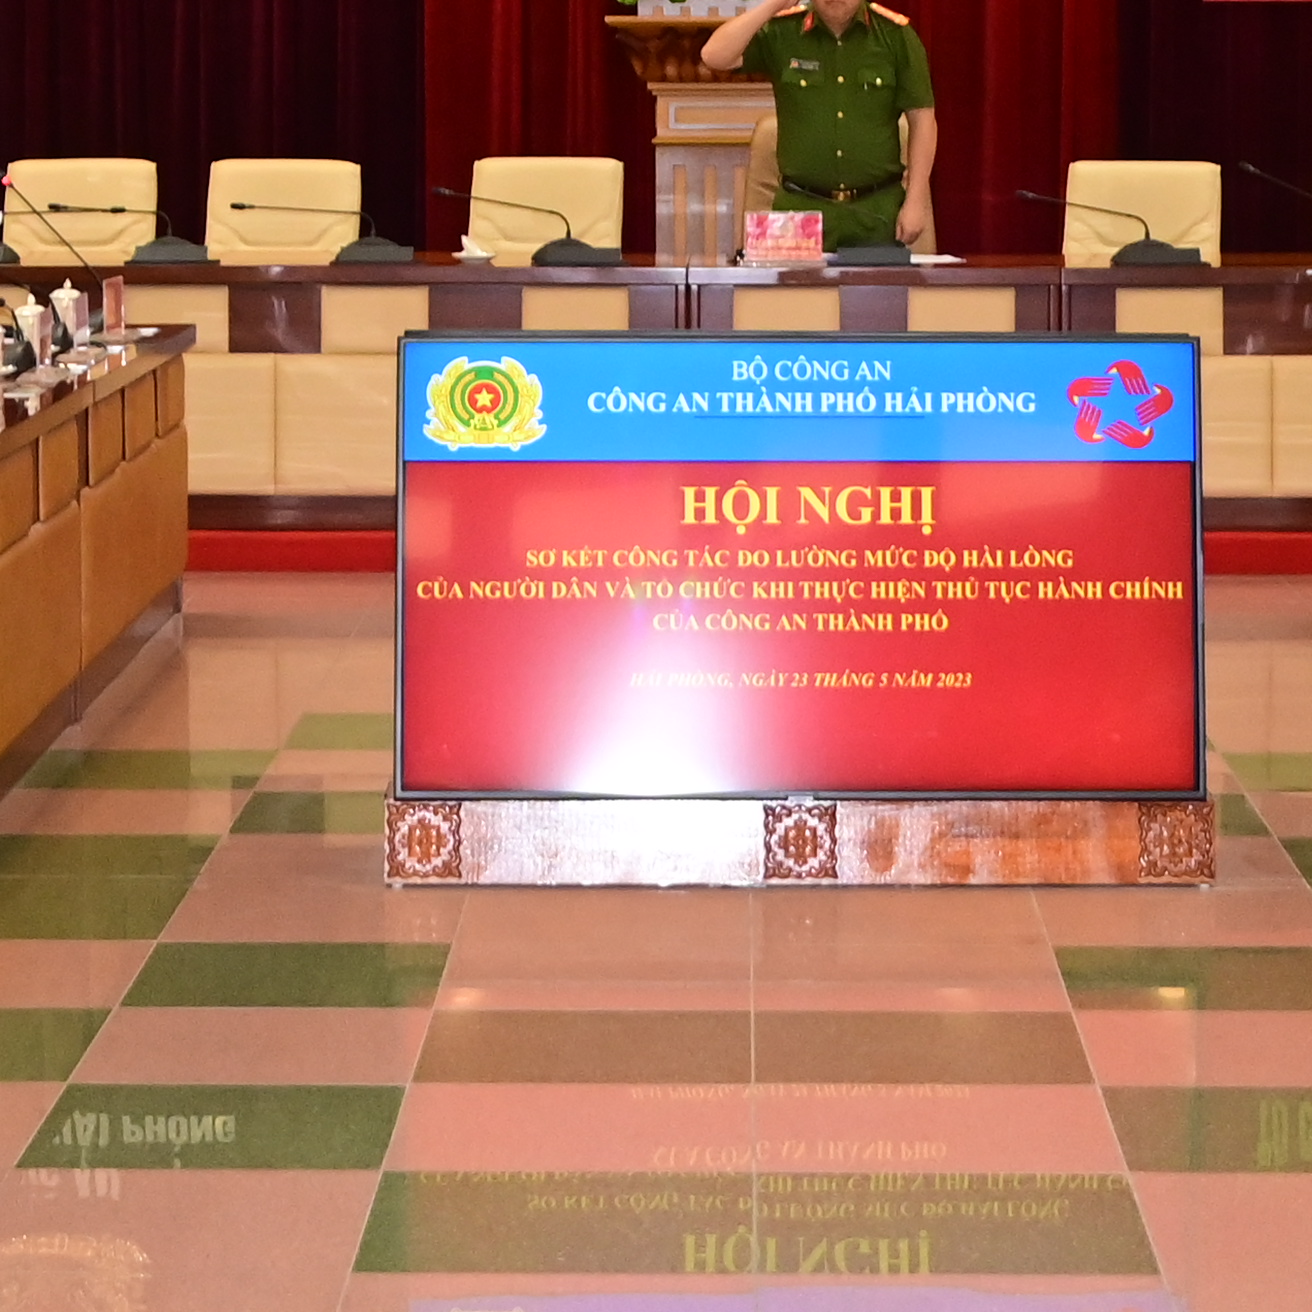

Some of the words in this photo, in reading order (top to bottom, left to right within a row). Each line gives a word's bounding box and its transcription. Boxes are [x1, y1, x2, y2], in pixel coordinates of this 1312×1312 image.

[733, 355, 768, 384] BỘ
[775, 355, 849, 381] CÔNG
[855, 361, 891, 380] AN
[588, 386, 666, 412] CÔNG
[673, 392, 708, 412] AN
[717, 387, 813, 412] THÀNH
[885, 387, 932, 412] HẢI
[941, 387, 1035, 412] PHÒNG
[681, 480, 780, 535] HỘI
[797, 486, 935, 535] NGHỊ
[527, 549, 556, 567] SƠ
[613, 545, 677, 567] CÔNG
[684, 545, 730, 568] TÁC
[738, 550, 769, 567] ĐO
[776, 545, 856, 567] LƯỜNG
[865, 545, 917, 567] MỨC
[924, 548, 956, 571] ĐỘ
[963, 545, 1002, 567] HÀI
[1010, 545, 1073, 567] LÒNG
[417, 577, 463, 599] CỦA
[470, 576, 544, 599] NGƯỜI
[552, 577, 597, 598] DÂN
[605, 577, 635, 599] VÀ
[678, 576, 745, 599] CHỨC
[753, 582, 794, 599] KHI
[799, 579, 864, 603] THỰC
[871, 579, 925, 603] HIỆN
[932, 577, 978, 598] THỦ
[985, 581, 1030, 603] TỤC
[1039, 577, 1102, 599] HÀNH
[1109, 577, 1182, 599] CHÍNH
